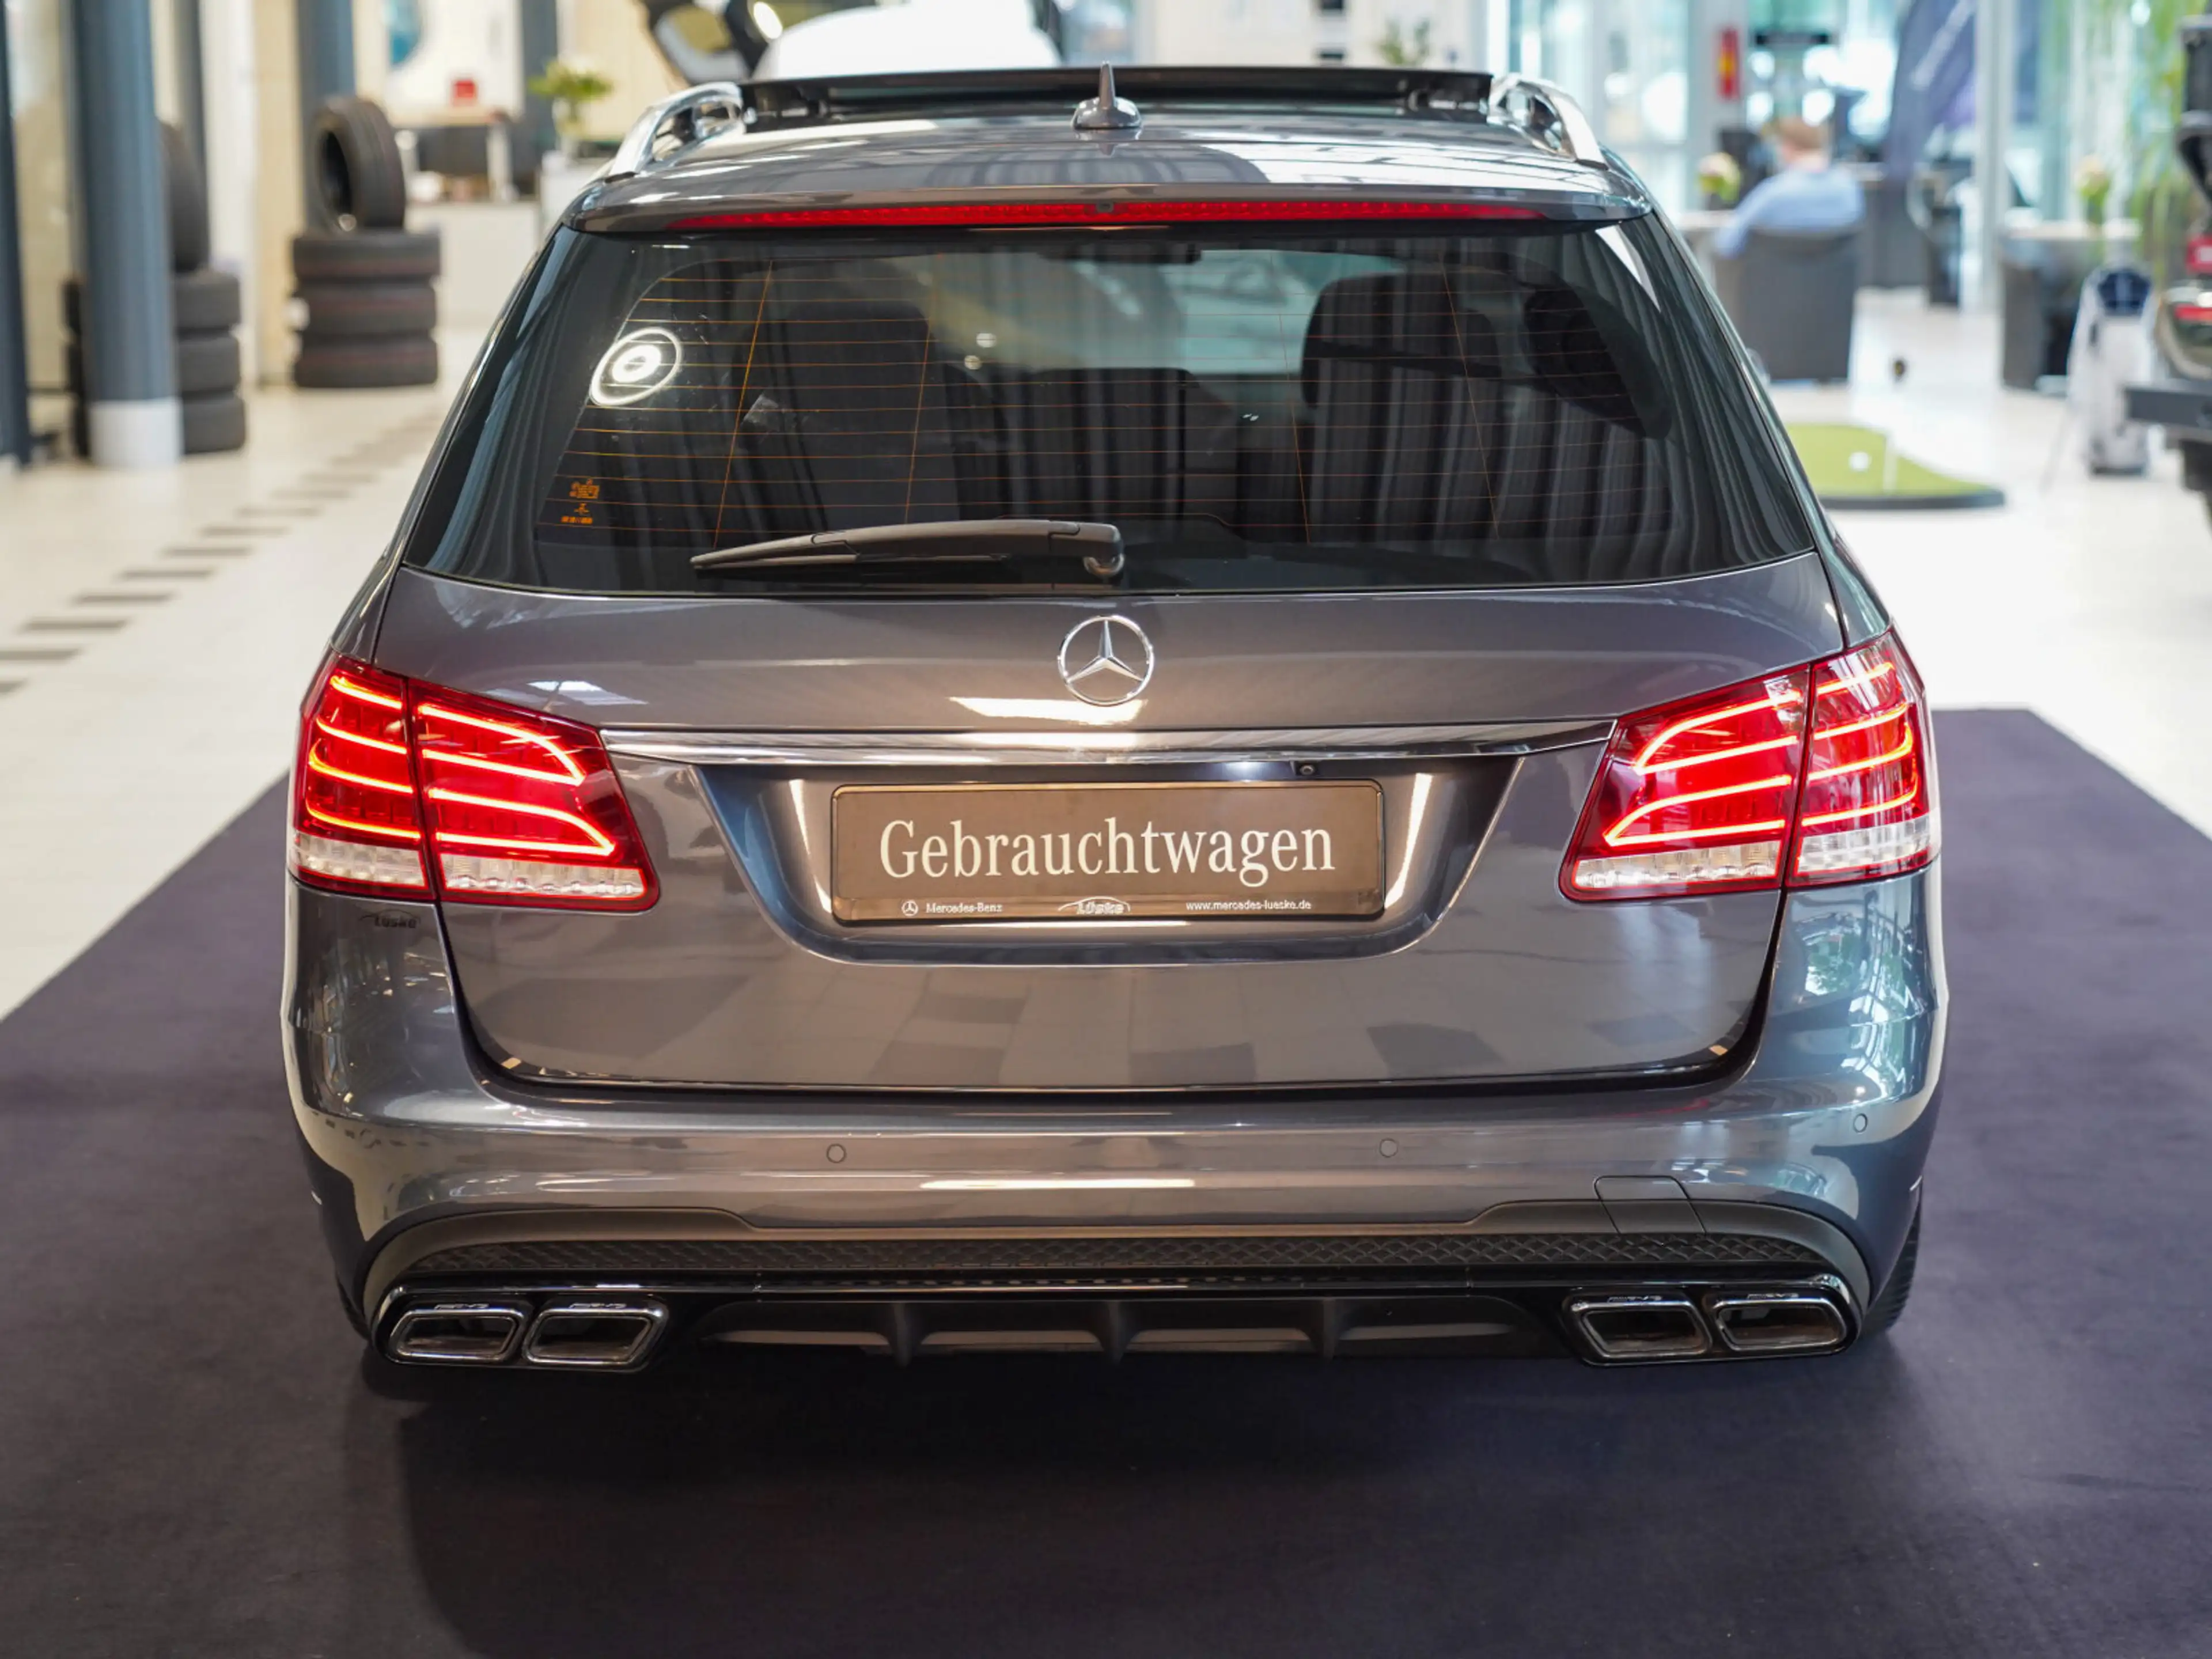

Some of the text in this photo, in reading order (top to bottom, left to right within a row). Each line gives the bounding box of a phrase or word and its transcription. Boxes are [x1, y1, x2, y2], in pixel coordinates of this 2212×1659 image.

[880, 817, 1335, 887] Gebrauchtwagen
[926, 902, 1002, 913] Mercedes-Benz
[1185, 900, 1311, 910] www.mercedes-lueske.de
